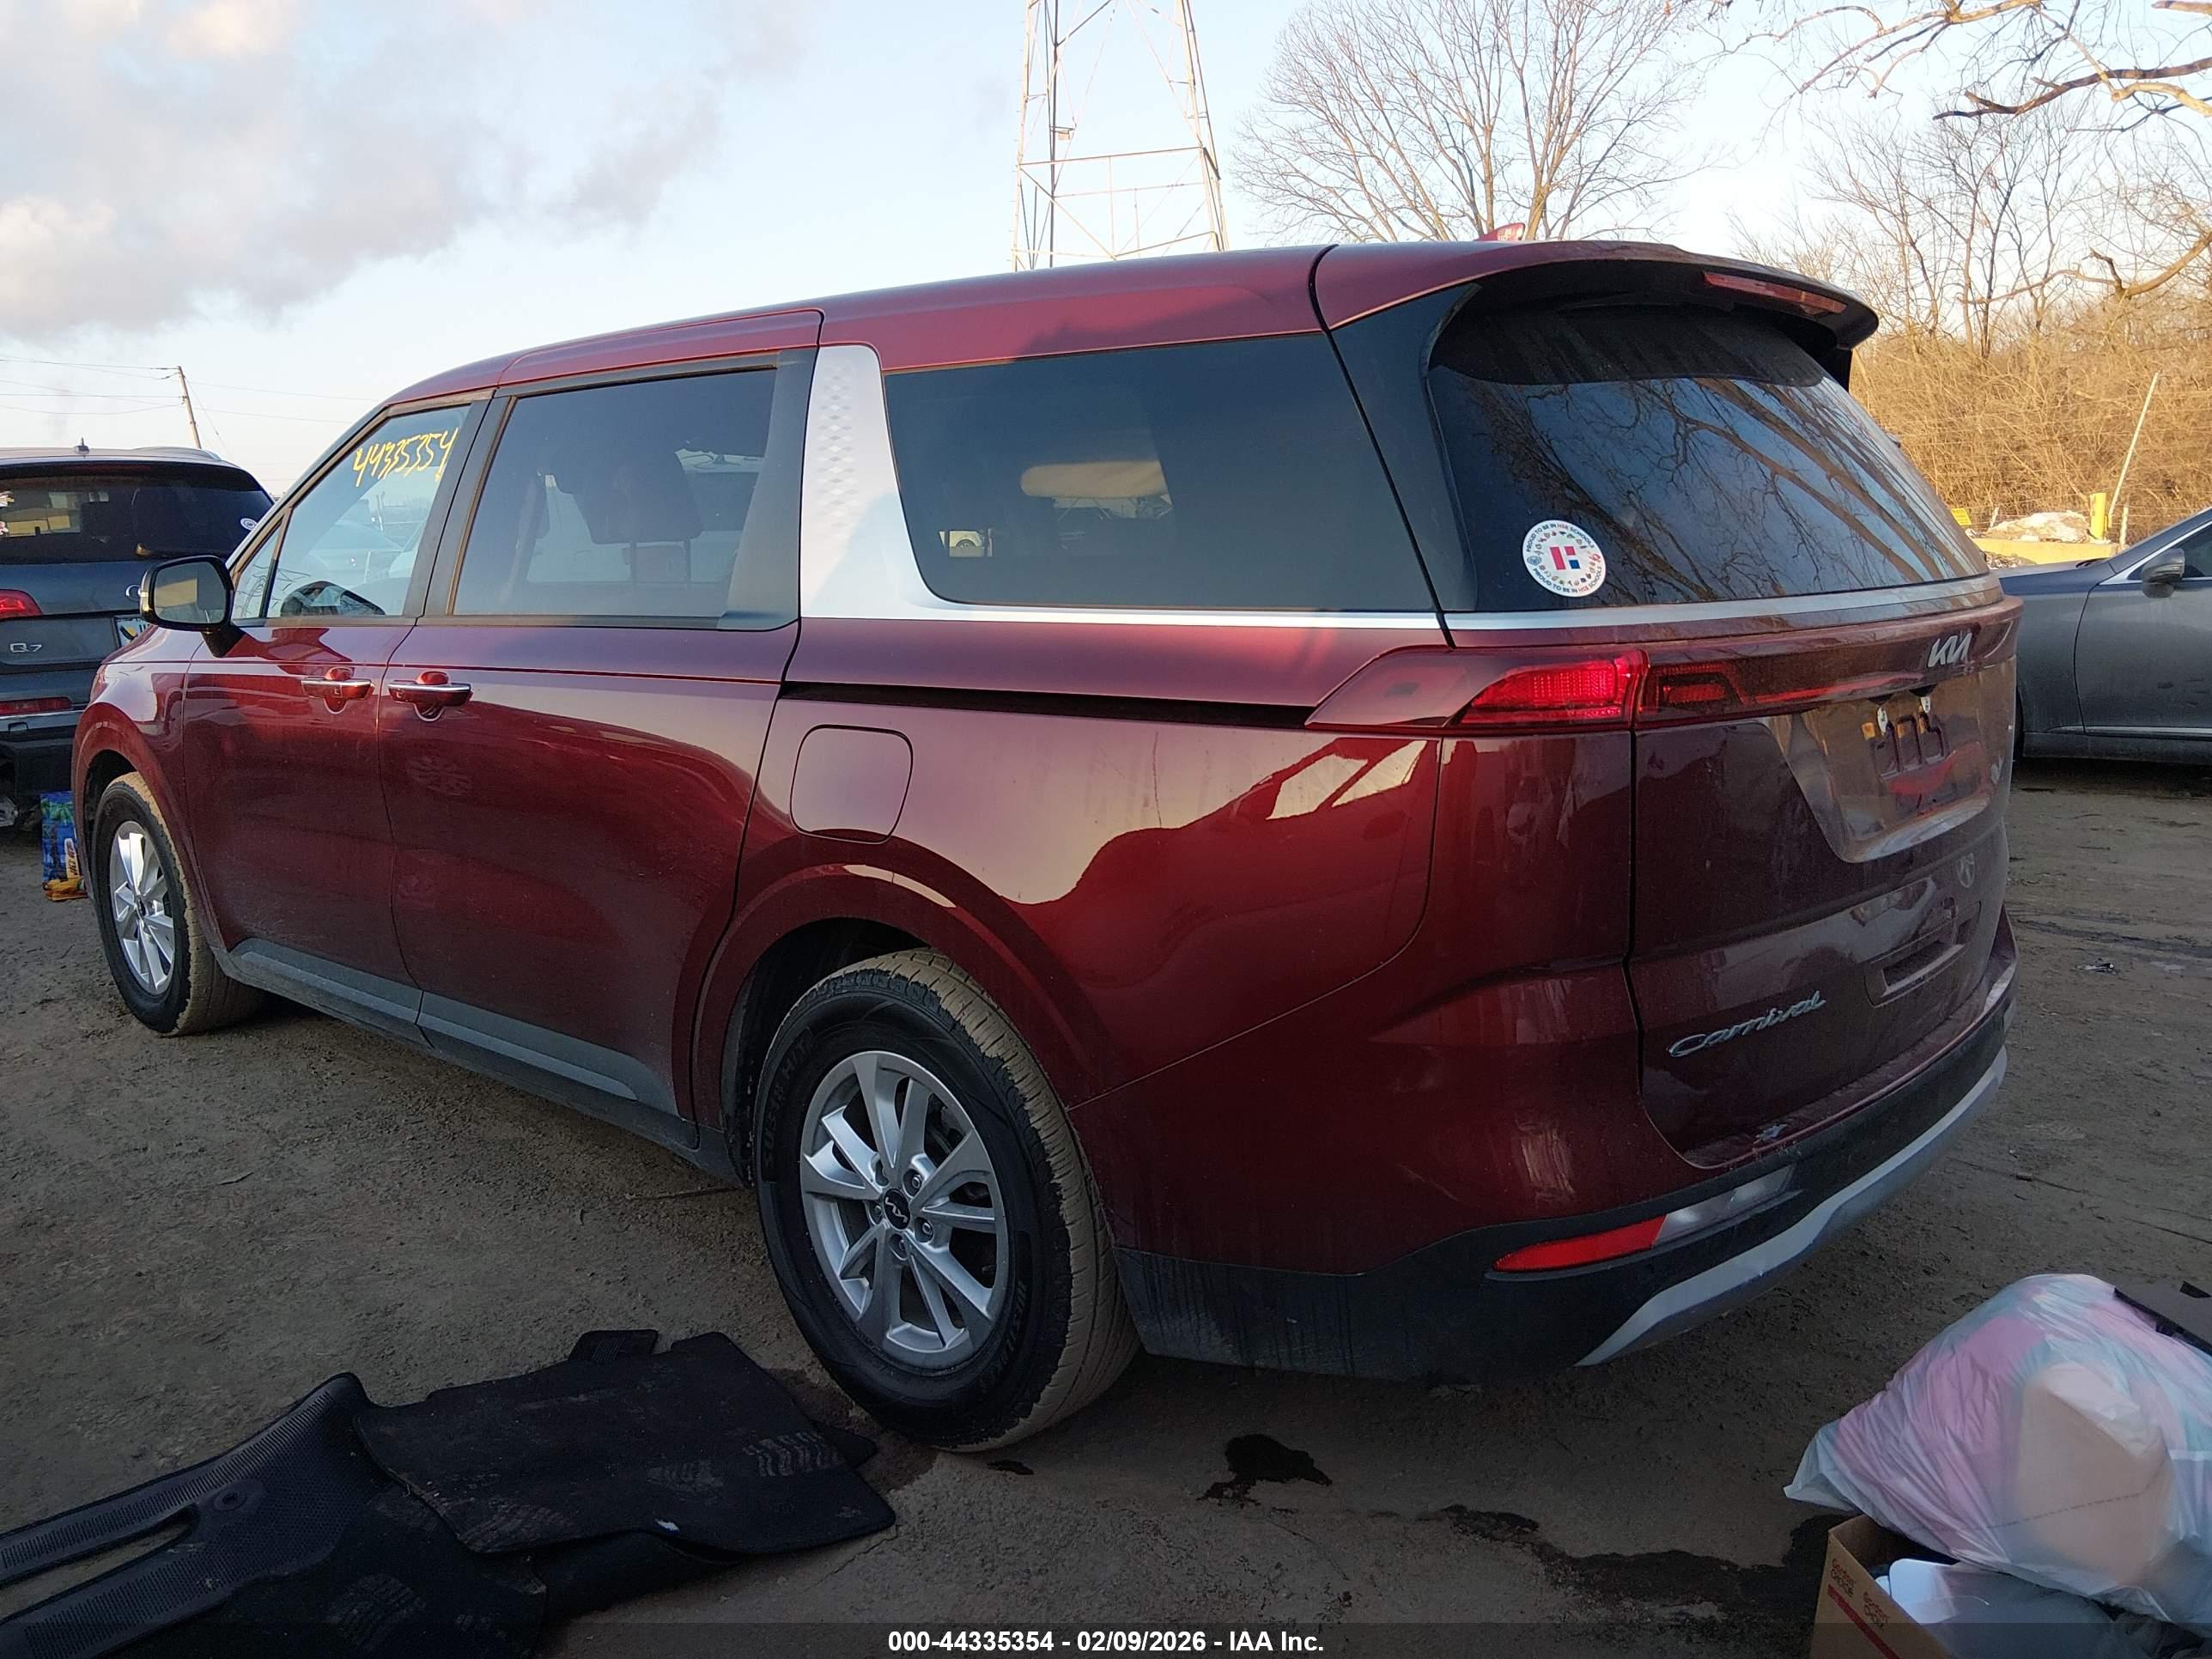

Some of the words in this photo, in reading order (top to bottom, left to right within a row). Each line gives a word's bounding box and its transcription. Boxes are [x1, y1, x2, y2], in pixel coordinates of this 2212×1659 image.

[353, 427, 459, 488] 44335354
[1527, 534, 1536, 552] PROUD
[1570, 526, 1595, 549] SCHOOLS
[1533, 568, 1552, 586] PROUD
[10, 642, 42, 653] Q7
[1666, 990, 1826, 1057] Carnival
